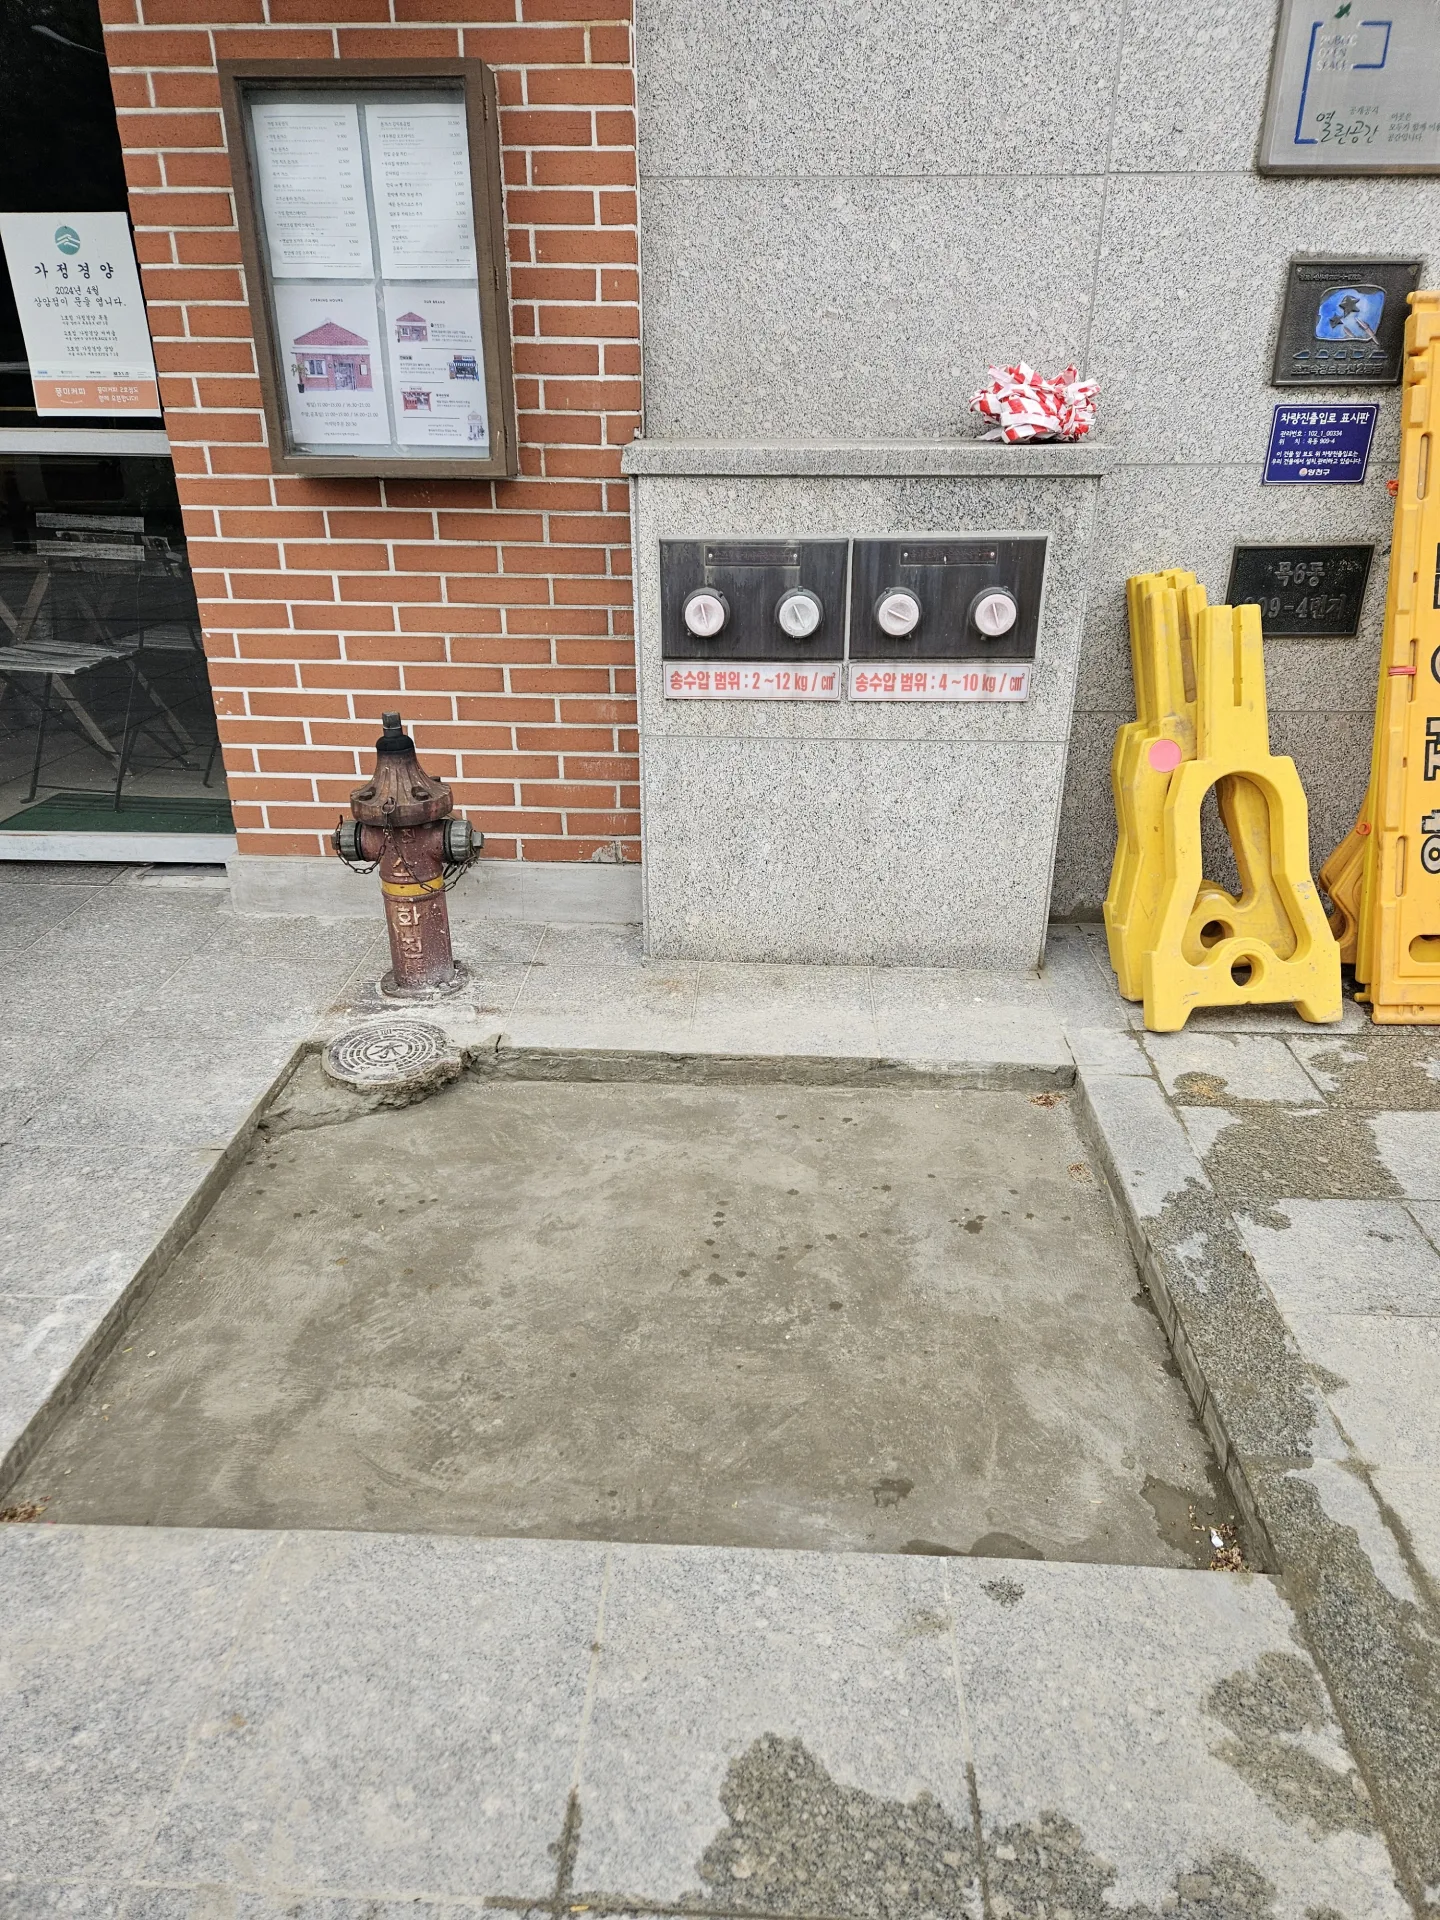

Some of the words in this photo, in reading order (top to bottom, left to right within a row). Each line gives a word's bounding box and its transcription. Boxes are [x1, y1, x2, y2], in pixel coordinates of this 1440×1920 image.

[34, 262, 114, 279] 가정경양
[55, 285, 82, 296] 2024년
[86, 285, 99, 296] 4월
[1280, 412, 1337, 425] 차량진출입로
[1340, 411, 1370, 425] 표시판
[1280, 430, 1303, 438] 관리번호
[1307, 468, 1330, 476] 양천구
[1274, 561, 1326, 587] 목6동
[1244, 594, 1347, 621] 09-4번지
[670, 670, 710, 690] 송수압
[714, 671, 741, 690] 범위
[855, 672, 897, 692] 송수압
[900, 672, 927, 692] 범위
